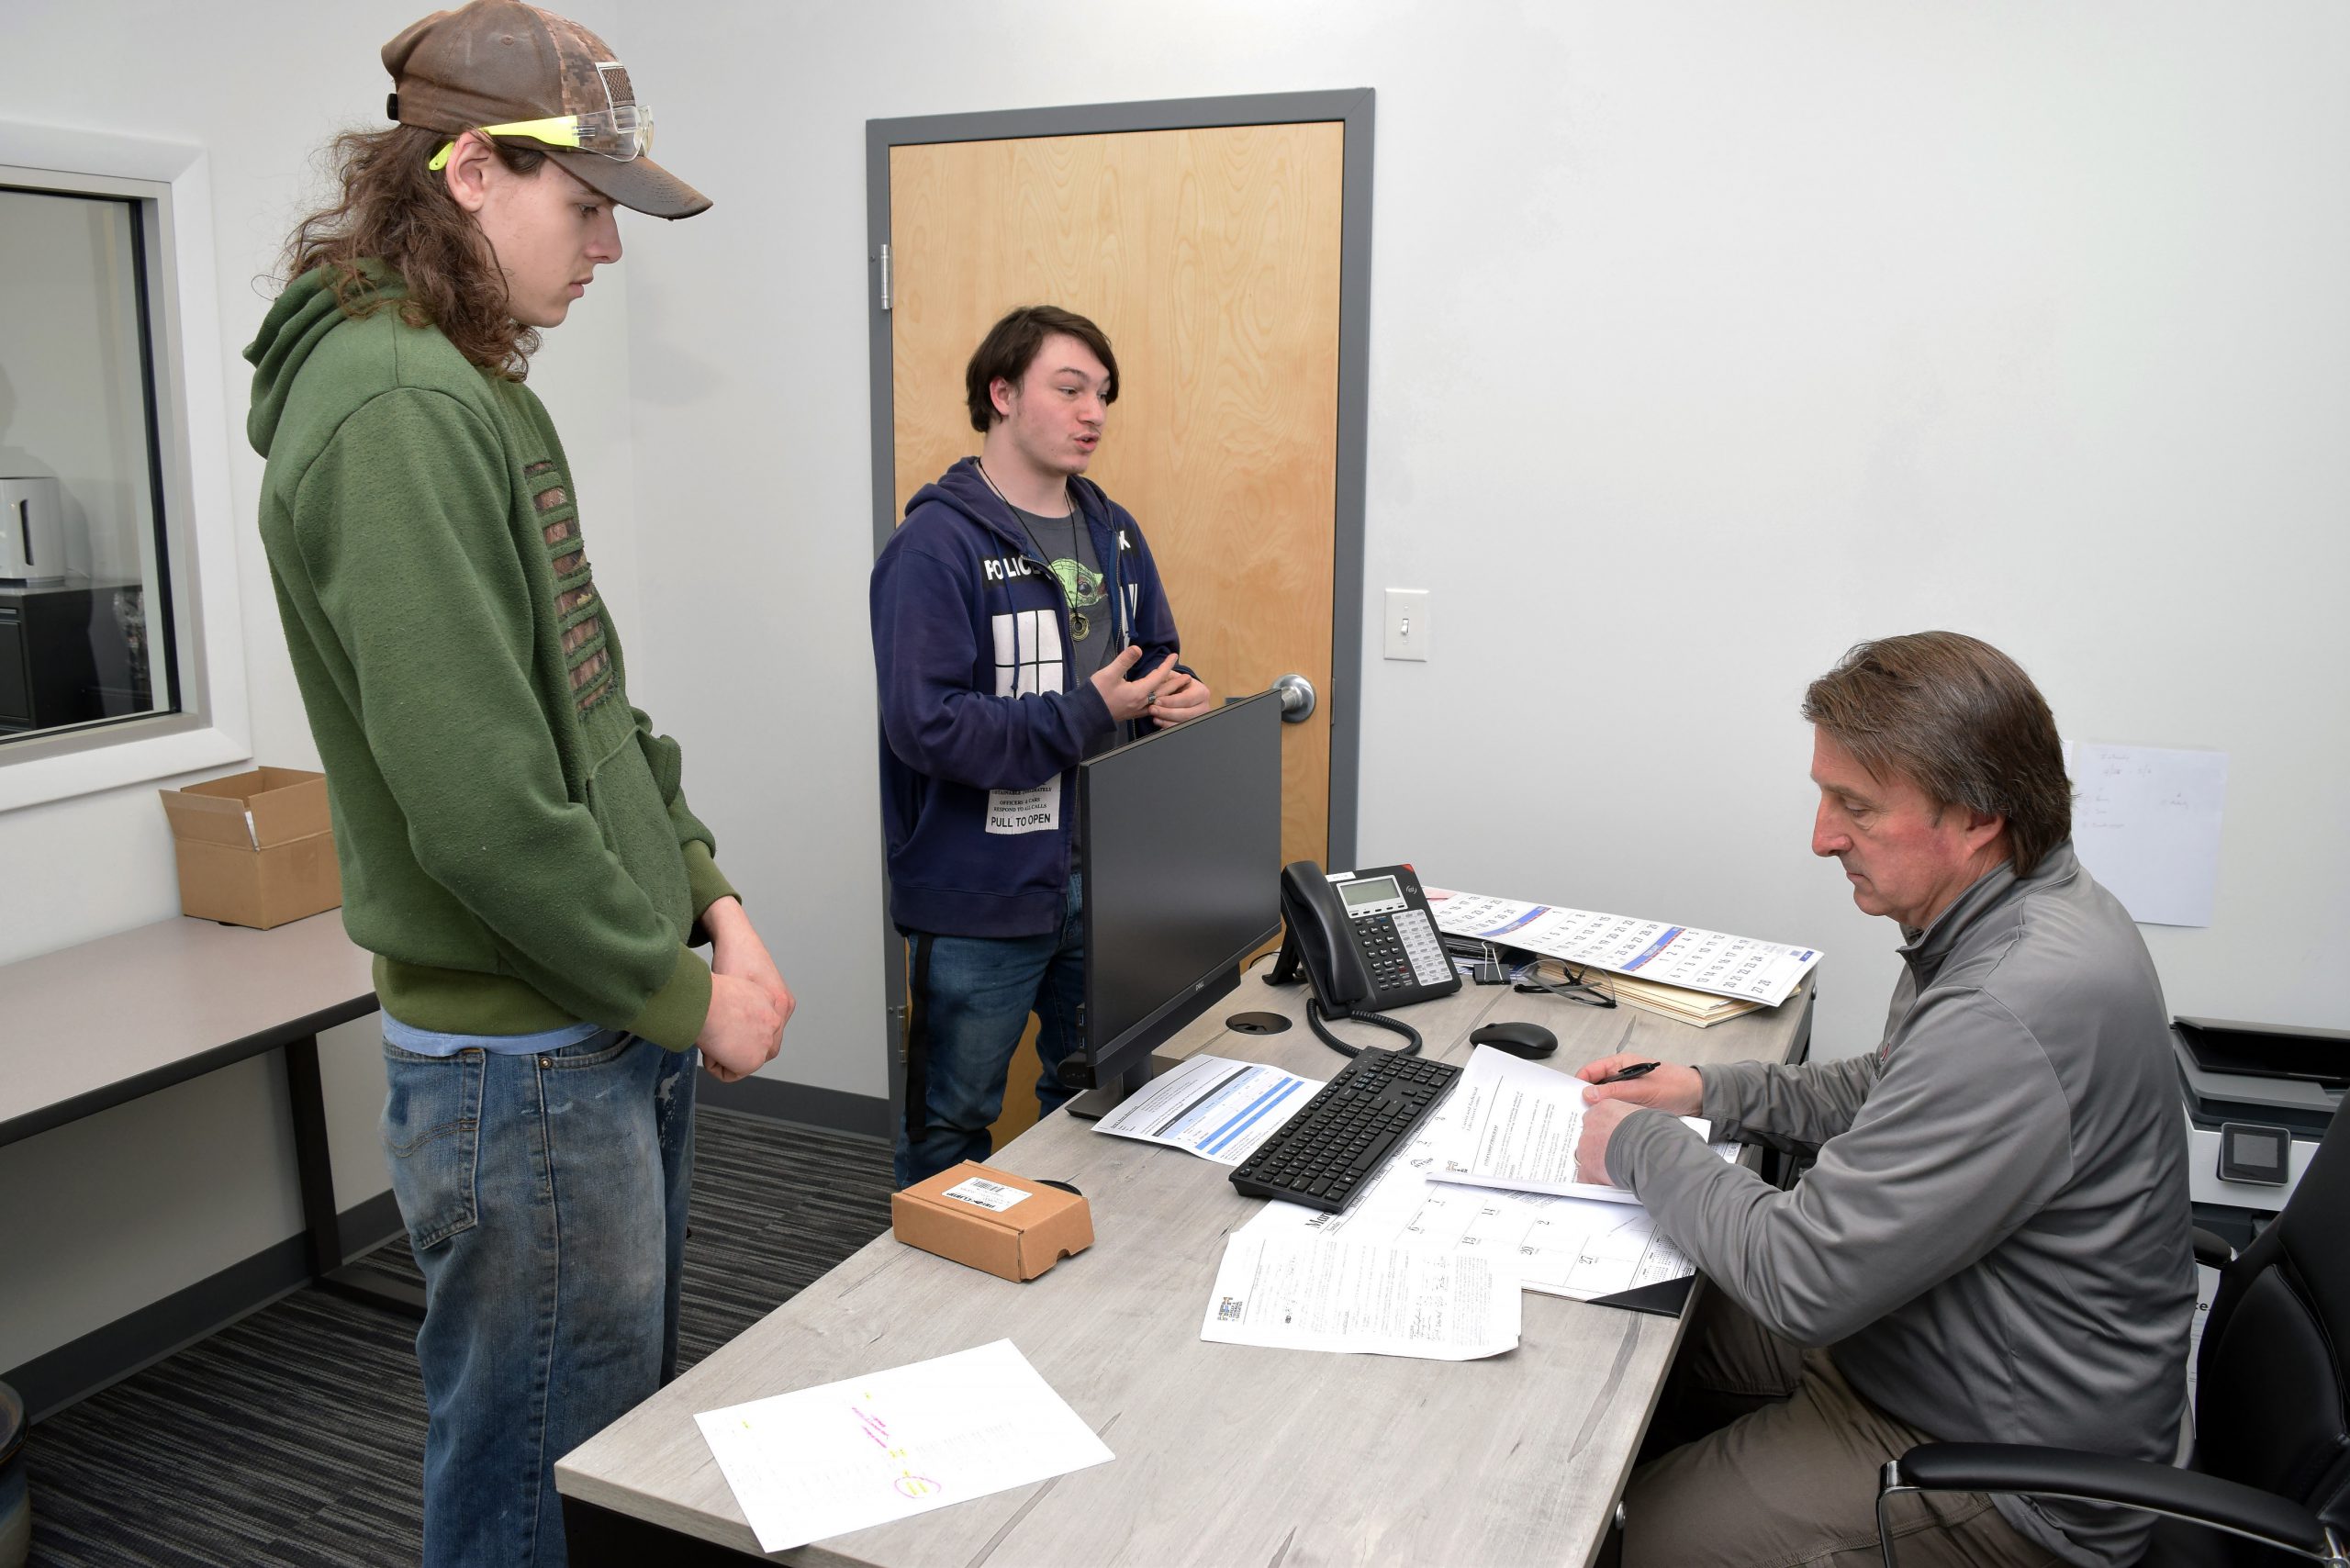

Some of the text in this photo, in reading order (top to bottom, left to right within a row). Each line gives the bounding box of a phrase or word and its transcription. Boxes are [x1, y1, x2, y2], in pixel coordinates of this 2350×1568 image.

[991, 813, 1050, 827] PULL TO OPEN
[1462, 1237, 1476, 1245] 13
[1520, 1247, 1534, 1255] 20
[1579, 1255, 1594, 1264] 27
